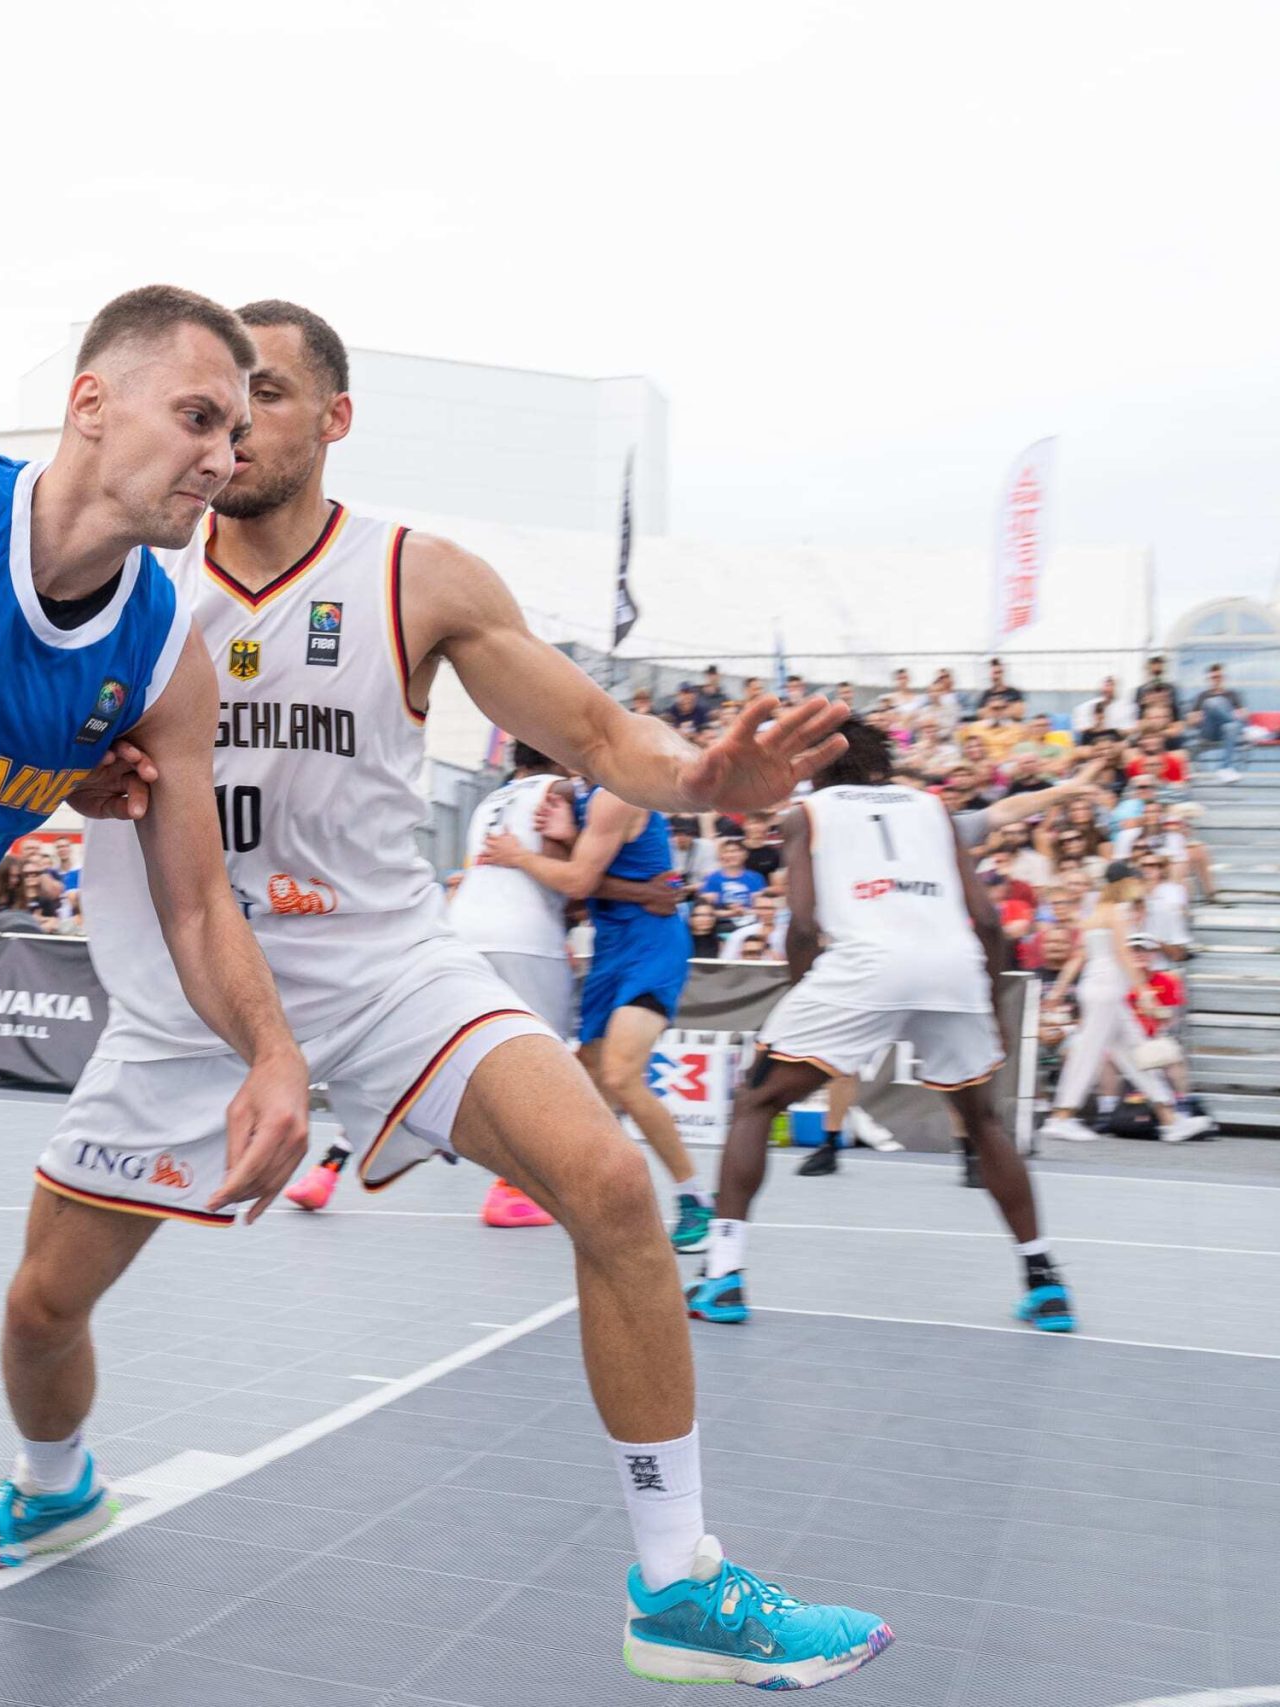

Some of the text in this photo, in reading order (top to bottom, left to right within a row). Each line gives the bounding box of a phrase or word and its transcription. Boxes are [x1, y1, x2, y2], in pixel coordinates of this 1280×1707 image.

[311, 638, 336, 650] FIBA
[84, 718, 110, 733] FIBA
[868, 813, 899, 862] 1
[74, 1142, 148, 1181] ING
